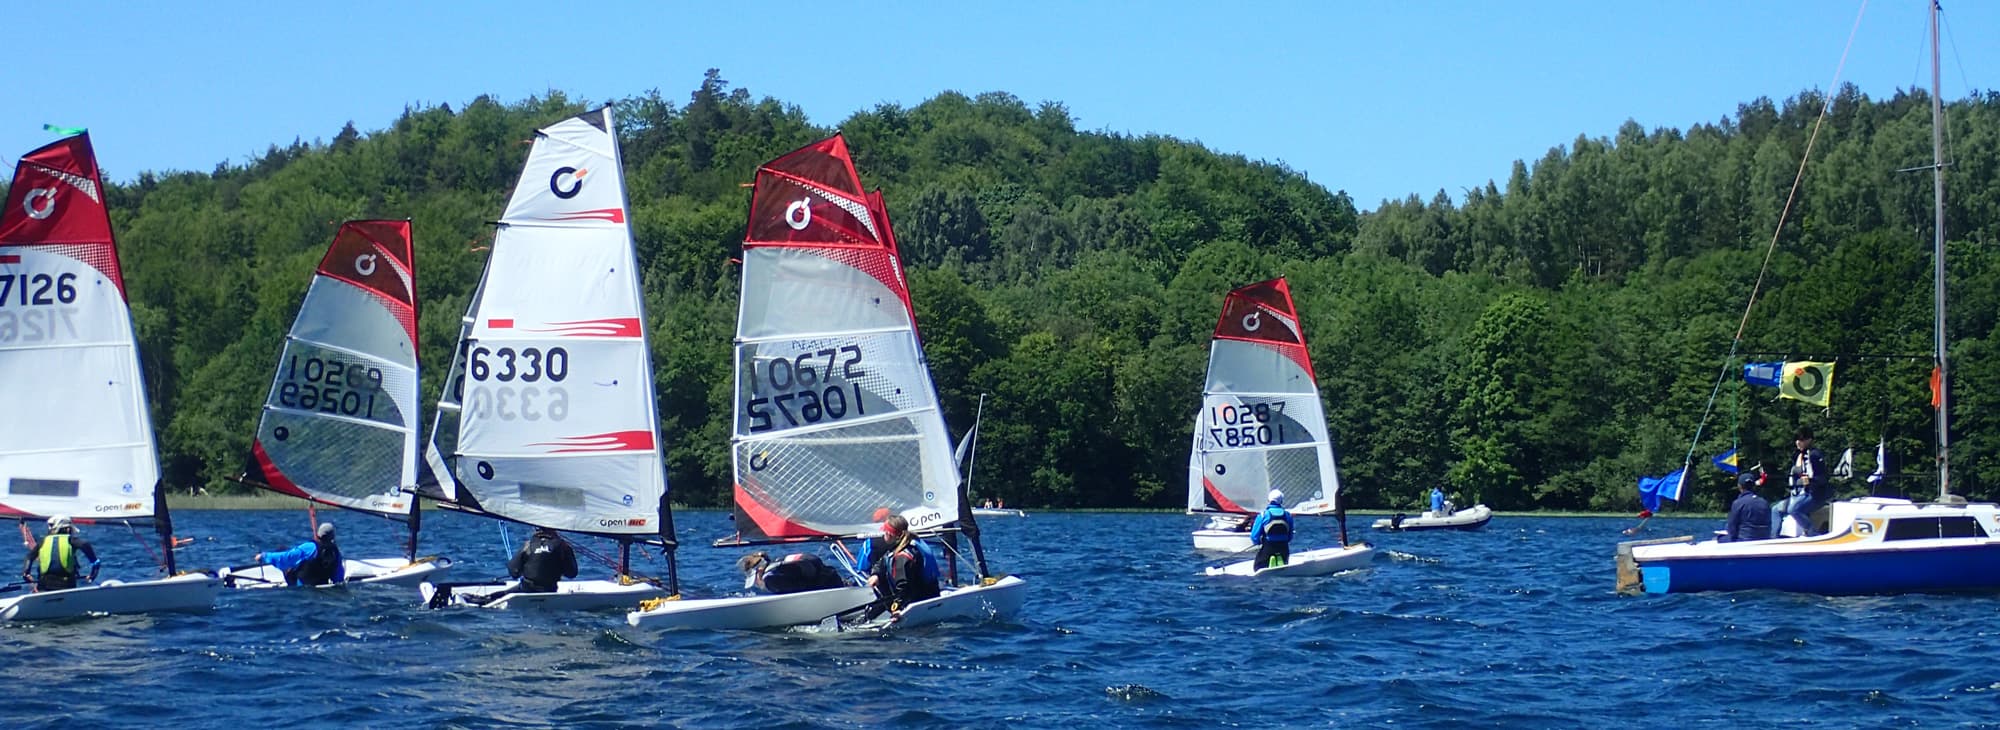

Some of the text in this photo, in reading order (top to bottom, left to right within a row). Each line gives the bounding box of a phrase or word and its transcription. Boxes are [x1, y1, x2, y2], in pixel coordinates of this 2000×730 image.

[0, 273, 77, 306] 7126
[471, 347, 569, 382] 6330
[750, 344, 865, 393] 10672
[1212, 401, 1285, 426] 10287
